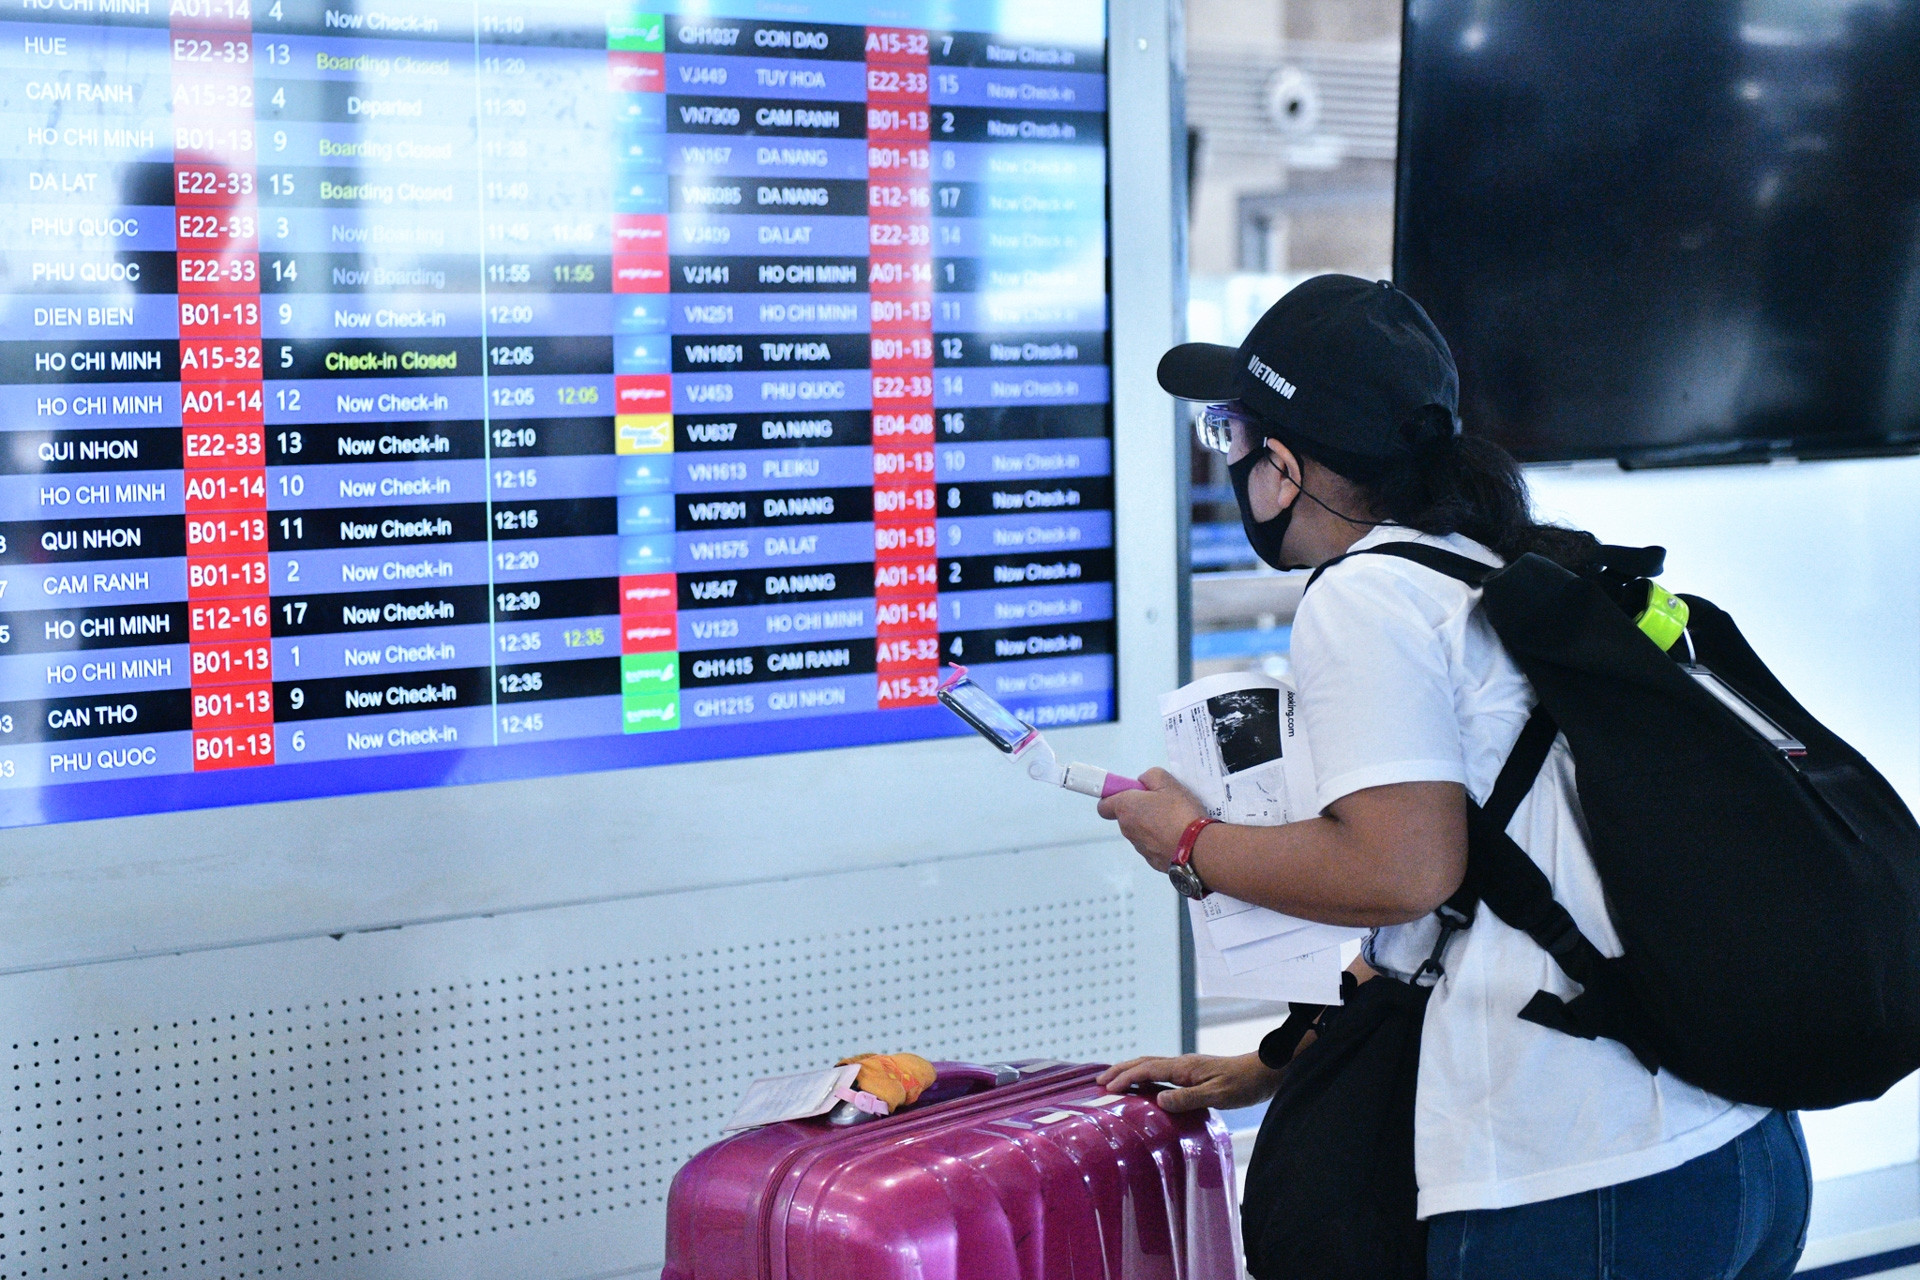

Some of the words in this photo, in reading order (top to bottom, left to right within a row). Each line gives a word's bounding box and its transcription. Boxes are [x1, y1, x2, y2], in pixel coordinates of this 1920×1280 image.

[170, 0, 250, 19] A01-14
[268, 0, 283, 21] 4
[24, 37, 67, 56] HUE
[755, 30, 790, 48] CON
[793, 32, 828, 49] DAO
[865, 33, 928, 55] A15-32
[941, 37, 953, 56] 7
[174, 39, 250, 63] E22-33
[265, 44, 291, 65] 13
[316, 53, 390, 76] Boarding
[394, 57, 449, 75] Closed
[867, 70, 928, 92] E22-33
[937, 74, 959, 95] 15
[26, 82, 71, 101] CAM
[77, 84, 133, 103] RANH
[271, 87, 286, 108] 4
[756, 108, 792, 126] CAM
[794, 109, 840, 129] RANH
[867, 109, 929, 131] B01-13
[941, 112, 955, 132] 2
[273, 130, 287, 152] 9
[29, 172, 56, 191] DA
[62, 173, 97, 192] LAT
[178, 172, 253, 195] E22-33
[270, 174, 295, 195] 15
[870, 187, 929, 208] E12-16
[939, 188, 960, 208] 17
[179, 215, 254, 239] E22-33
[276, 217, 289, 238] 3
[33, 263, 74, 280] PHU
[80, 263, 140, 282] QUOC
[180, 260, 255, 282] E22-33
[272, 260, 297, 282] 14
[489, 265, 530, 283] 11:55
[759, 266, 784, 283] HO
[786, 266, 814, 283] CHI
[817, 266, 856, 283] MINH
[869, 263, 931, 284] A01-14
[944, 263, 955, 284] 1
[34, 308, 82, 326] DIEN
[88, 308, 133, 325] BIEN
[181, 304, 258, 326] B01-13
[279, 304, 292, 325] 9
[334, 310, 371, 328] Now
[375, 309, 446, 327] Check-in
[490, 306, 533, 324] 12:00
[180, 347, 261, 370] A15-32
[280, 346, 293, 368] 5
[490, 346, 534, 365] 12:05
[761, 344, 793, 361] TUY
[795, 343, 831, 361] HOA
[871, 338, 932, 359] B01-13
[941, 338, 963, 359] 12
[35, 353, 66, 371] HO
[71, 352, 105, 370] CHI
[111, 351, 161, 370] MINH
[325, 352, 397, 370] Check-in
[401, 351, 457, 370] Closed
[1247, 354, 1297, 400] VIETNAM
[37, 398, 67, 416] HO
[72, 397, 106, 415] CHI
[112, 396, 163, 414] MINH
[182, 391, 262, 413] A01-14
[276, 389, 301, 411] 12
[337, 395, 374, 412] Now
[378, 393, 448, 411] Check-in
[491, 388, 535, 406] 12:05
[942, 413, 964, 434] 16
[186, 433, 262, 457] E22-33
[277, 431, 302, 453] 13
[492, 428, 536, 447] 12:10
[38, 442, 74, 461] QUI
[80, 440, 138, 460] NHON
[185, 476, 265, 501] A01-14
[279, 475, 304, 496] 10
[494, 469, 537, 489] 12:15
[40, 487, 70, 505] HO
[75, 485, 109, 504] CHI
[115, 483, 166, 503] MINH
[874, 490, 935, 512] B01-13
[947, 488, 960, 508] 8
[280, 517, 303, 539] 11
[340, 522, 377, 540] Now
[381, 518, 452, 539] Check-in
[495, 510, 538, 530] 12:15
[41, 532, 77, 551] QUI
[83, 528, 141, 549] NHON
[188, 519, 265, 543] B01-13
[496, 550, 539, 570] 12:20
[190, 563, 266, 587] B01-13
[287, 561, 300, 582] 2
[875, 565, 936, 588] A01-14
[949, 563, 962, 583] 2
[43, 575, 88, 594] CAM
[94, 572, 149, 592] RANH
[497, 591, 540, 612] 12:30
[192, 605, 267, 631] E12-16
[282, 602, 308, 625] 17
[343, 605, 380, 625] Now
[383, 600, 454, 622] Check-in
[45, 620, 75, 640] HO
[80, 618, 114, 638] CHI
[120, 614, 170, 636] MINH
[498, 632, 541, 652] 12:35
[876, 639, 938, 663] A15-32
[950, 636, 963, 657] 4
[193, 648, 269, 674] B01-13
[291, 645, 300, 667] 1
[767, 653, 803, 672] CAM
[805, 649, 849, 669] RANH
[47, 665, 76, 684] HO
[82, 662, 116, 682] CHI
[122, 658, 172, 680] MINH
[499, 672, 543, 693] 12:35
[877, 676, 938, 701] A15-32
[194, 690, 270, 717] B01-13
[290, 687, 305, 709] 9
[346, 690, 382, 709] Now
[386, 684, 456, 705] Check-in
[48, 708, 90, 729] CAN
[95, 704, 138, 724] THO
[501, 713, 543, 733] 12:45
[196, 733, 272, 760] B01-13
[292, 730, 305, 751] 6
[347, 732, 383, 750] Now
[387, 725, 458, 747] Check-in
[50, 752, 92, 773] PHU
[97, 747, 157, 770] QUOC
